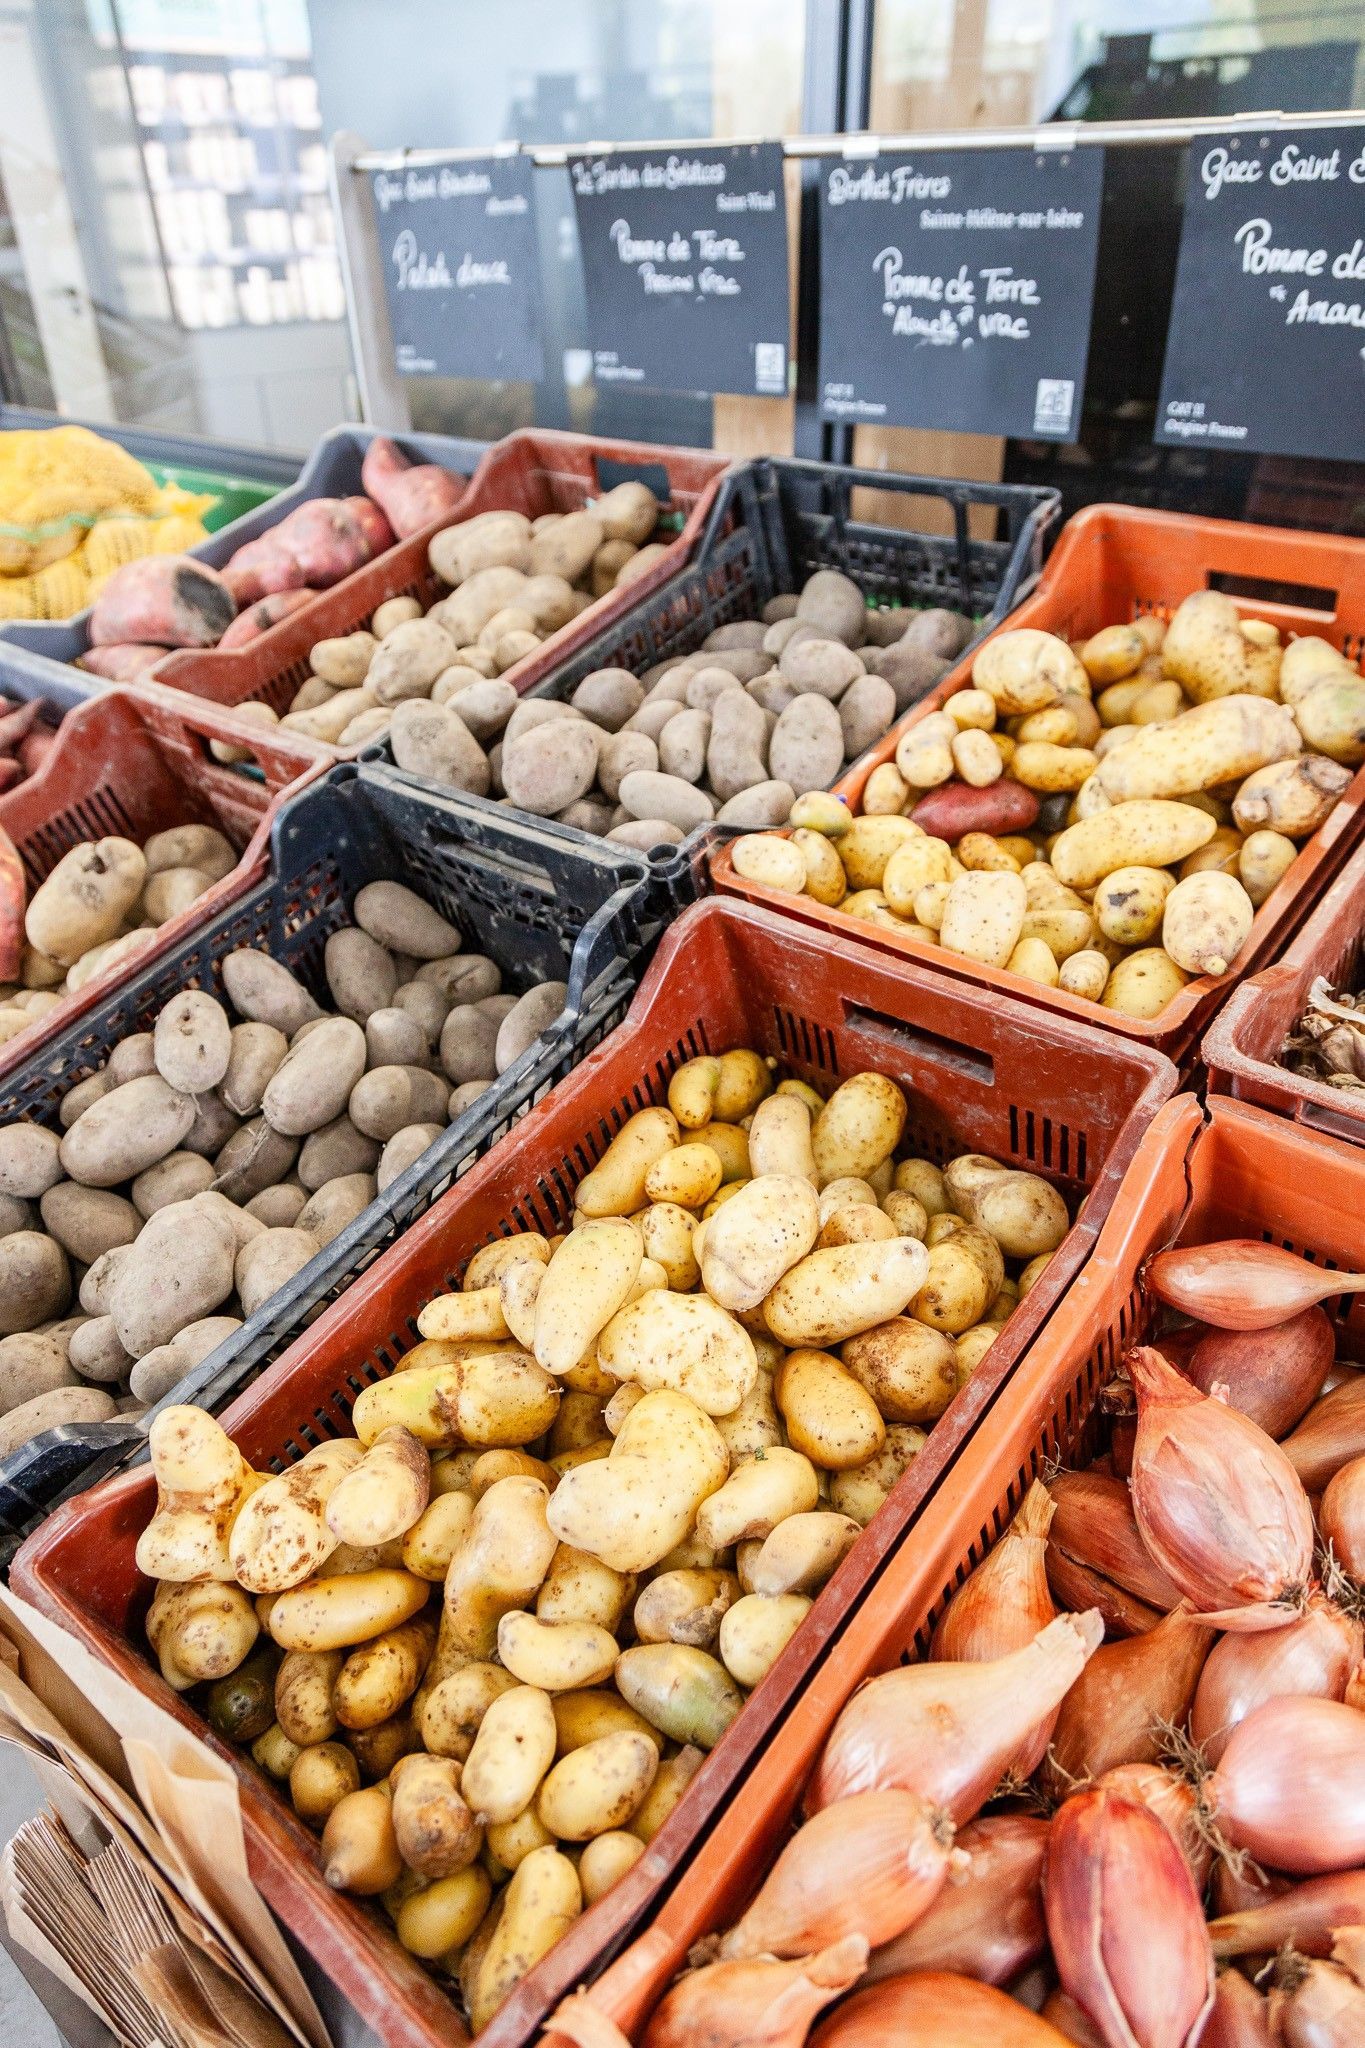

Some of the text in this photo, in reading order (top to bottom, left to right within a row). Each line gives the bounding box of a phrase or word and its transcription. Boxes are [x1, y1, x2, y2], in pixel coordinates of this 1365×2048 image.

[1270, 144, 1341, 186] Saint
[666, 231, 692, 262] de
[691, 229, 746, 262] Terre
[1234, 218, 1328, 275] Pomme
[872, 246, 1041, 306] Pomme de Terre
